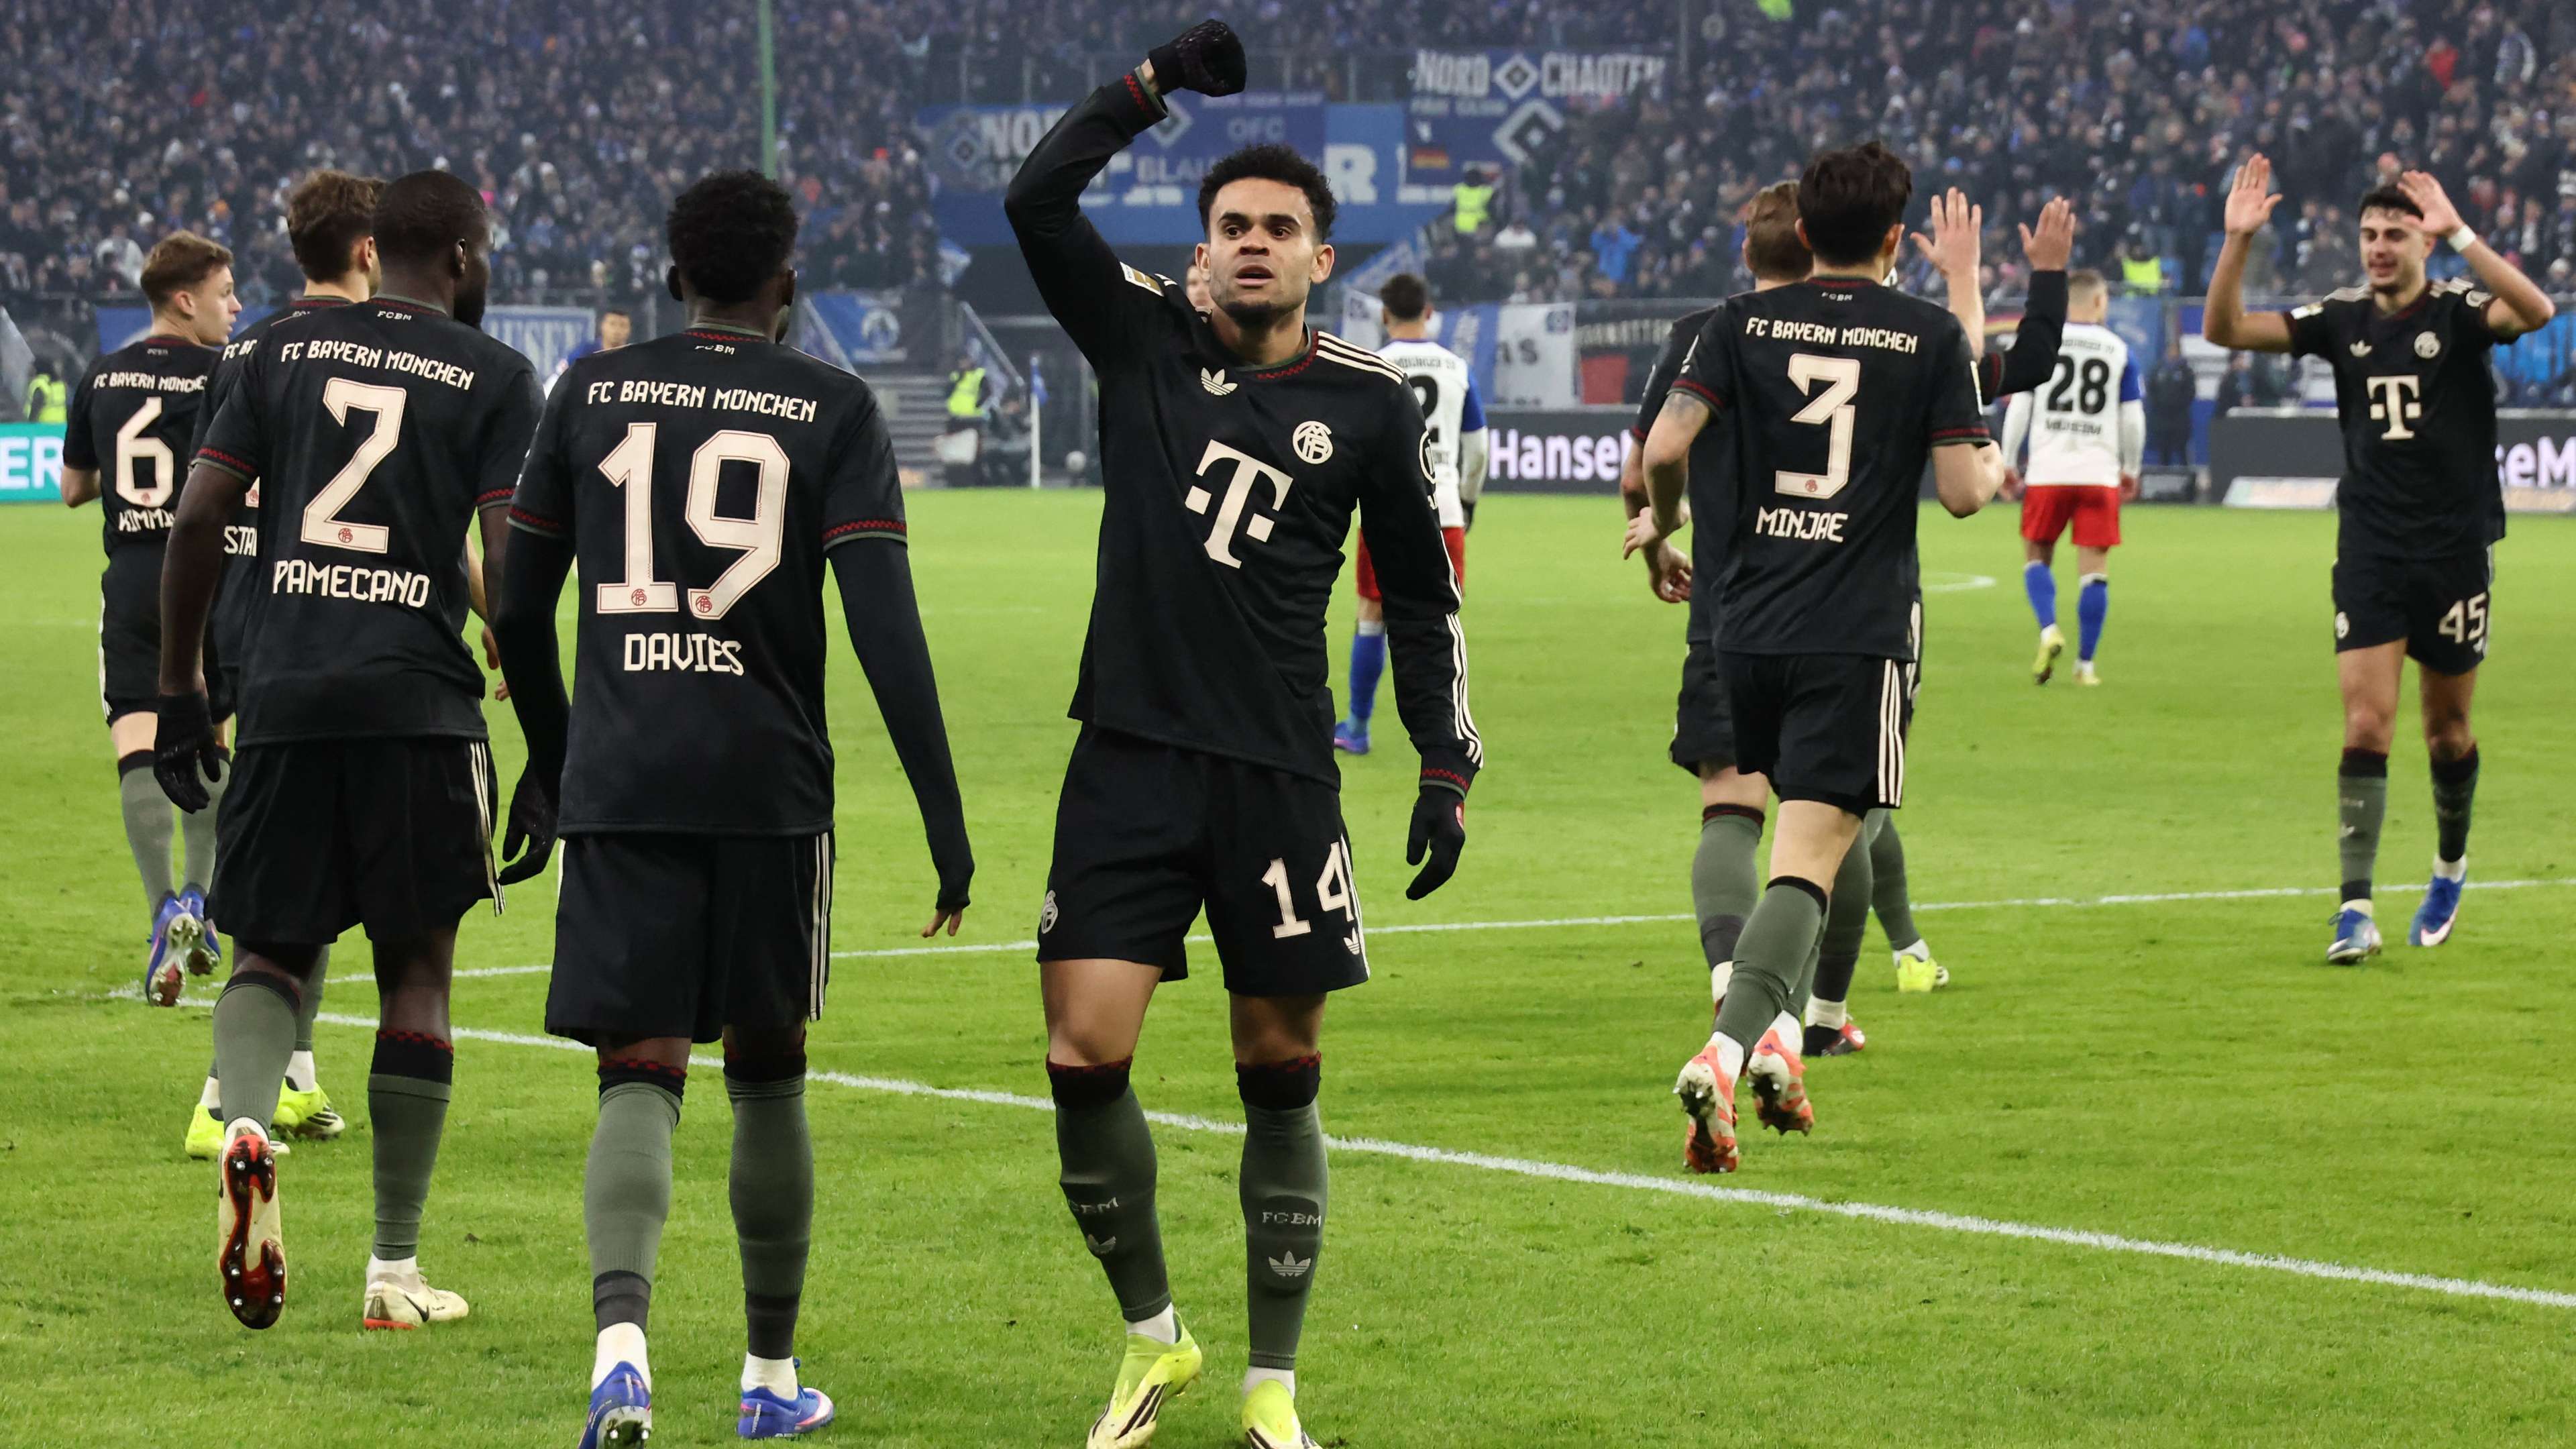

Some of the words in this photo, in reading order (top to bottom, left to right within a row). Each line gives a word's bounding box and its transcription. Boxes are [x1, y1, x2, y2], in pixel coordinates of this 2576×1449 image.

[377, 311, 412, 321] FCBM
[1746, 317, 1768, 337] FC
[1772, 319, 1837, 345] BAYERN
[1841, 327, 1918, 354] MÜNCHEN
[109, 372, 156, 390] BAYERN
[281, 342, 305, 362] FC
[307, 340, 382, 368] BAYERN
[384, 350, 474, 390] MÜNCHEN
[2048, 354, 2109, 414] 28
[588, 381, 615, 405] FC
[619, 380, 706, 408] BAYERN
[712, 387, 817, 423] MÜNCHEN
[1775, 353, 1860, 499] 3
[116, 396, 173, 507] 6
[301, 377, 407, 553] 2
[119, 508, 176, 533] KIMMI
[596, 422, 790, 620] 19
[1756, 506, 1849, 543] MINJAE
[272, 559, 430, 608] PAMECANO
[2438, 592, 2486, 643] 45
[624, 633, 744, 676] DAVIES
[1261, 842, 1356, 939] 14
[1261, 1211, 1322, 1228] FCBM
